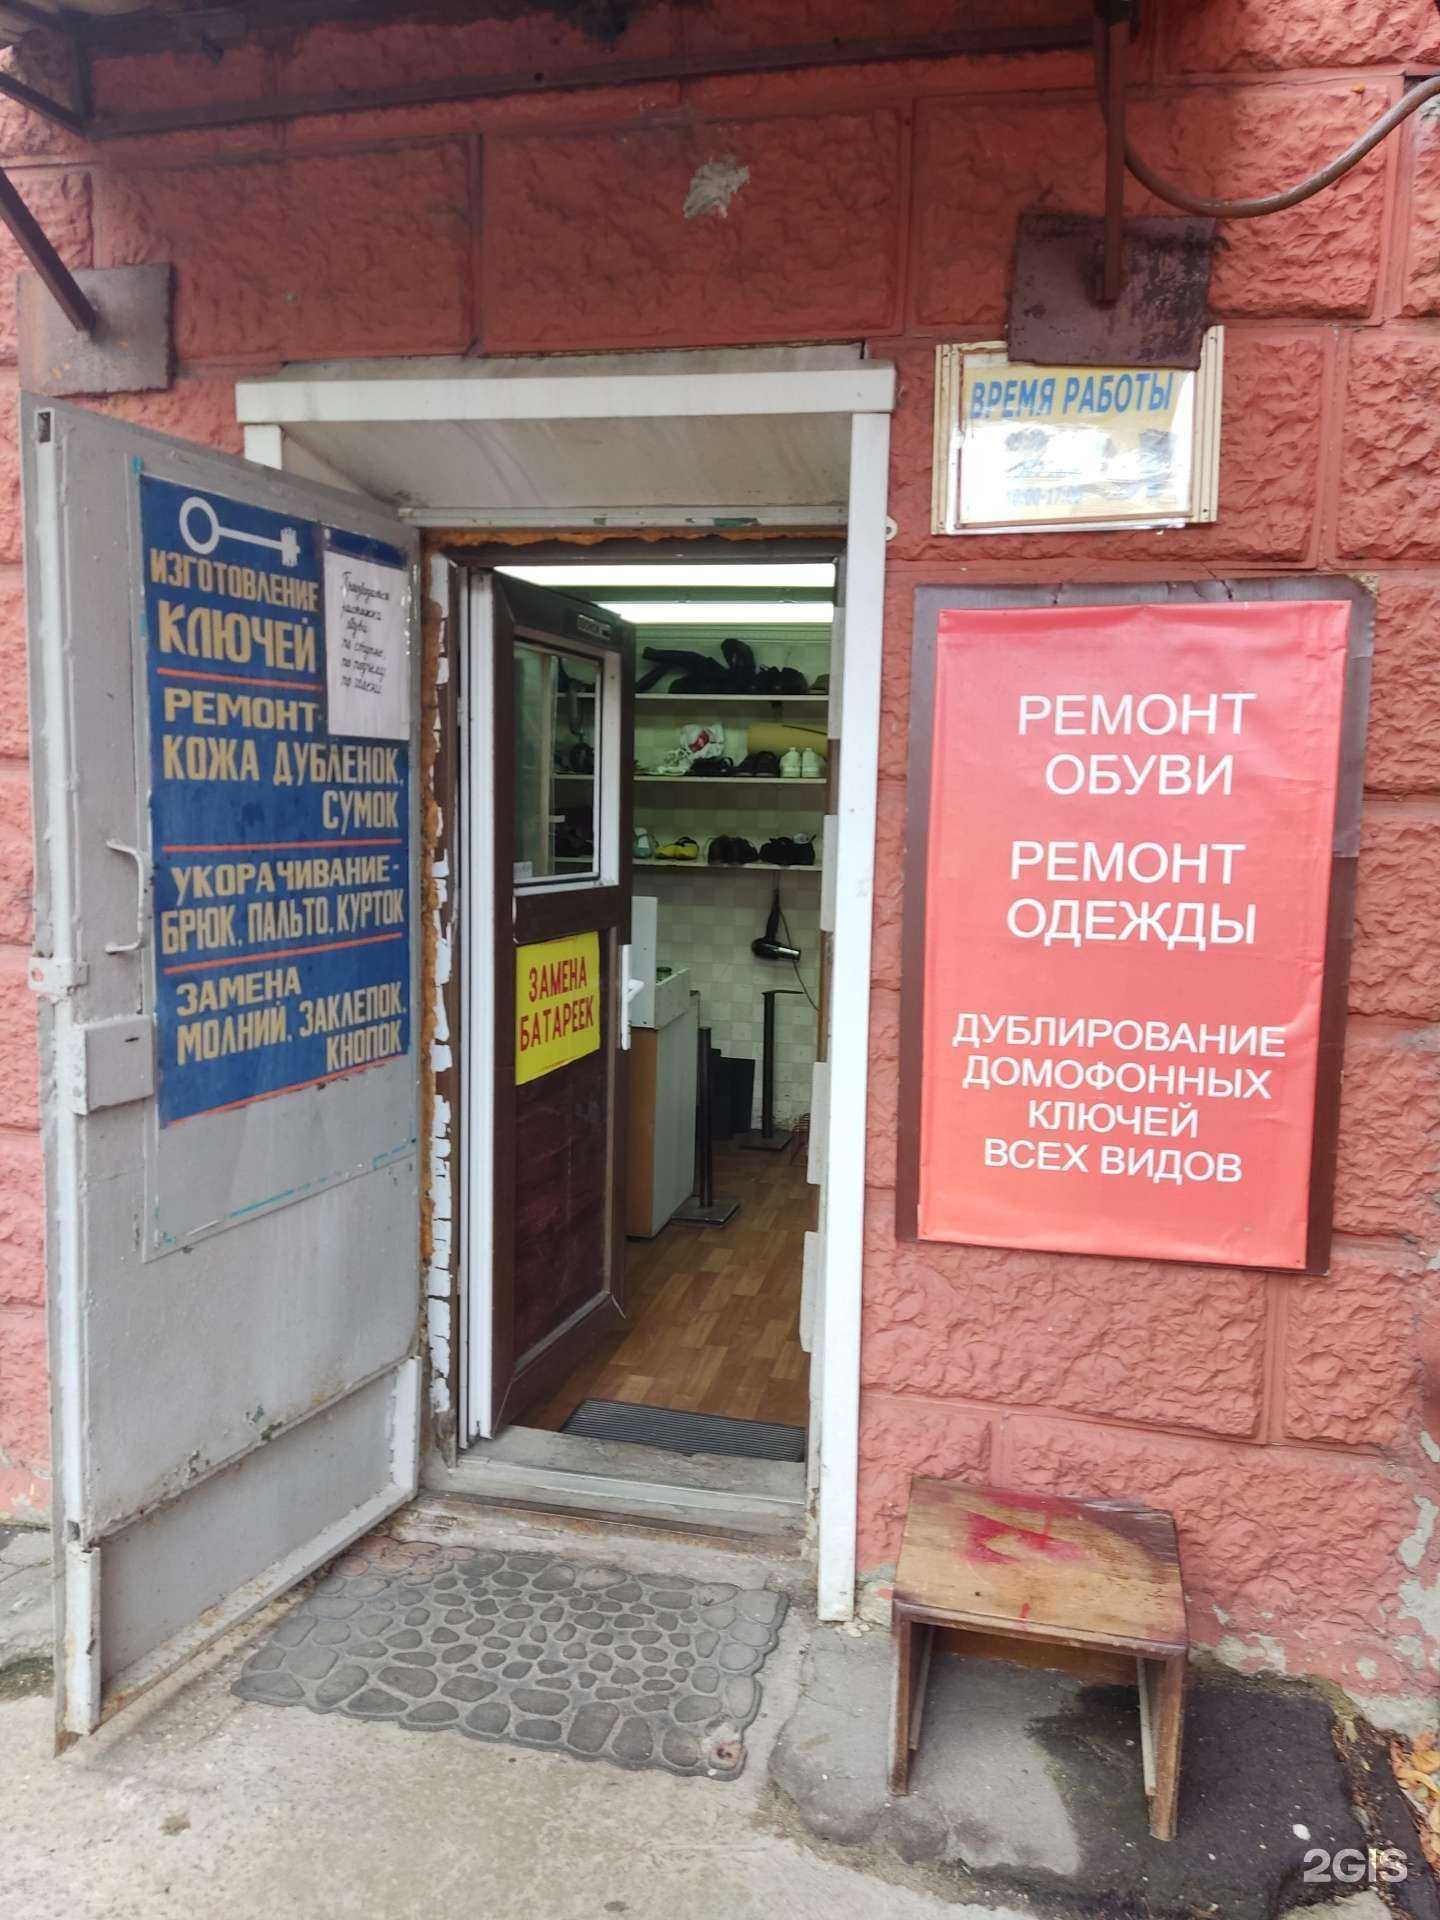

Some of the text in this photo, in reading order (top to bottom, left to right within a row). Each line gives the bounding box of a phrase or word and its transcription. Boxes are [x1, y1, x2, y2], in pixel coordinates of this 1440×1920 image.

[970, 372, 1174, 419] ВРЕМЯ РАБОТЫ
[151, 548, 319, 612] ИЗГОТОВЛЕНИЕ
[157, 600, 316, 673] КЛЮЧЕЙ
[1018, 693, 1257, 736] РЕМОНТ
[162, 735, 260, 781] КОЖА
[1045, 754, 1233, 796] ОБУВИ
[322, 789, 400, 835] СУМОК
[1010, 840, 1246, 884] РЕМОНТ
[337, 888, 404, 933] КУРТОК
[1007, 898, 1256, 951] ОДЕЖДЫ
[176, 966, 302, 1016] ЗАМЕНА
[529, 956, 587, 1002] ЗАМЕНА
[326, 1019, 402, 1072] КНОПОК
[520, 995, 593, 1052] БАТАРЕЕК
[952, 1013, 1286, 1058] ДУБЛИРОВАНИЕ
[962, 1055, 1273, 1099] ДОМОФОННЫХ
[1027, 1099, 1198, 1138] КЛЮЧЕЙ
[984, 1138, 1243, 1184] ВСЕХ ВИДОВ
